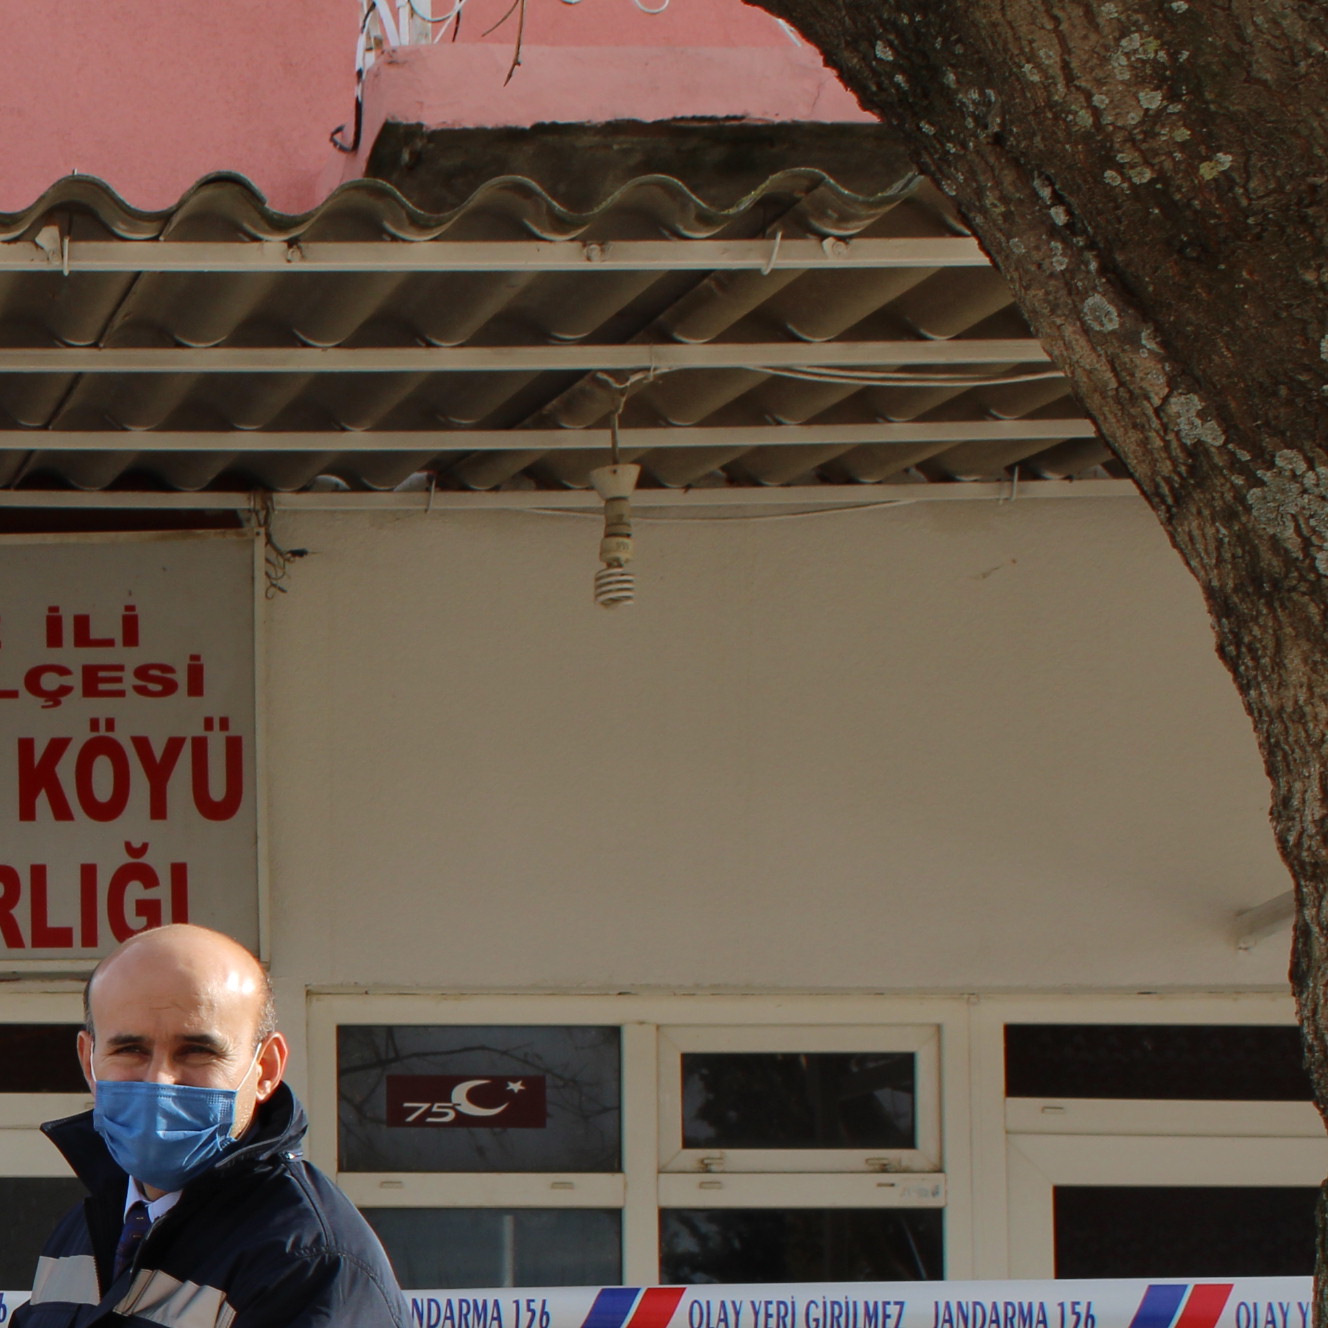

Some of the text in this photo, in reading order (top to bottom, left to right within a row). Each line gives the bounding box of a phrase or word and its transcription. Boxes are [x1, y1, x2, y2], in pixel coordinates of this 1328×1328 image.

[45, 604, 141, 649] İLİ
[16, 716, 244, 823] KÖYÜ
[402, 1102, 457, 1123] 75
